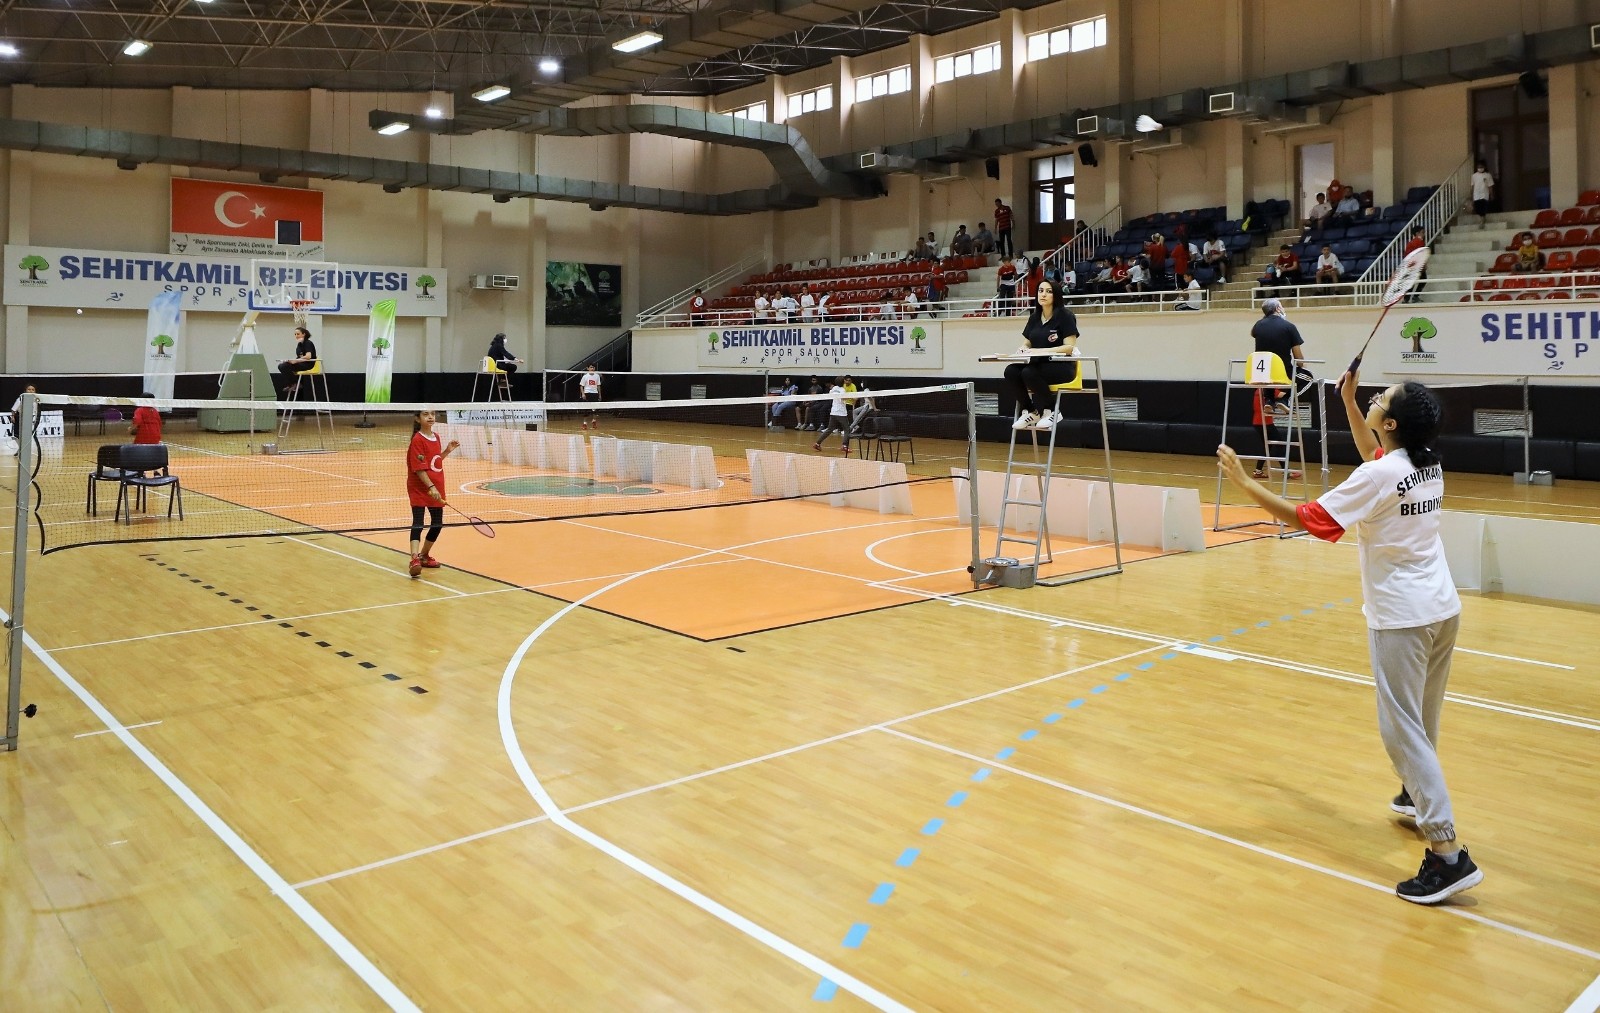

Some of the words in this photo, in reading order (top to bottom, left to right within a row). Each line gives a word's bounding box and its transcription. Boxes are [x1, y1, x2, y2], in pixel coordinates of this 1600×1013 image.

[764, 348, 793, 357] SPOR
[799, 347, 847, 357] SALONU
[1256, 359, 1265, 372] 4
